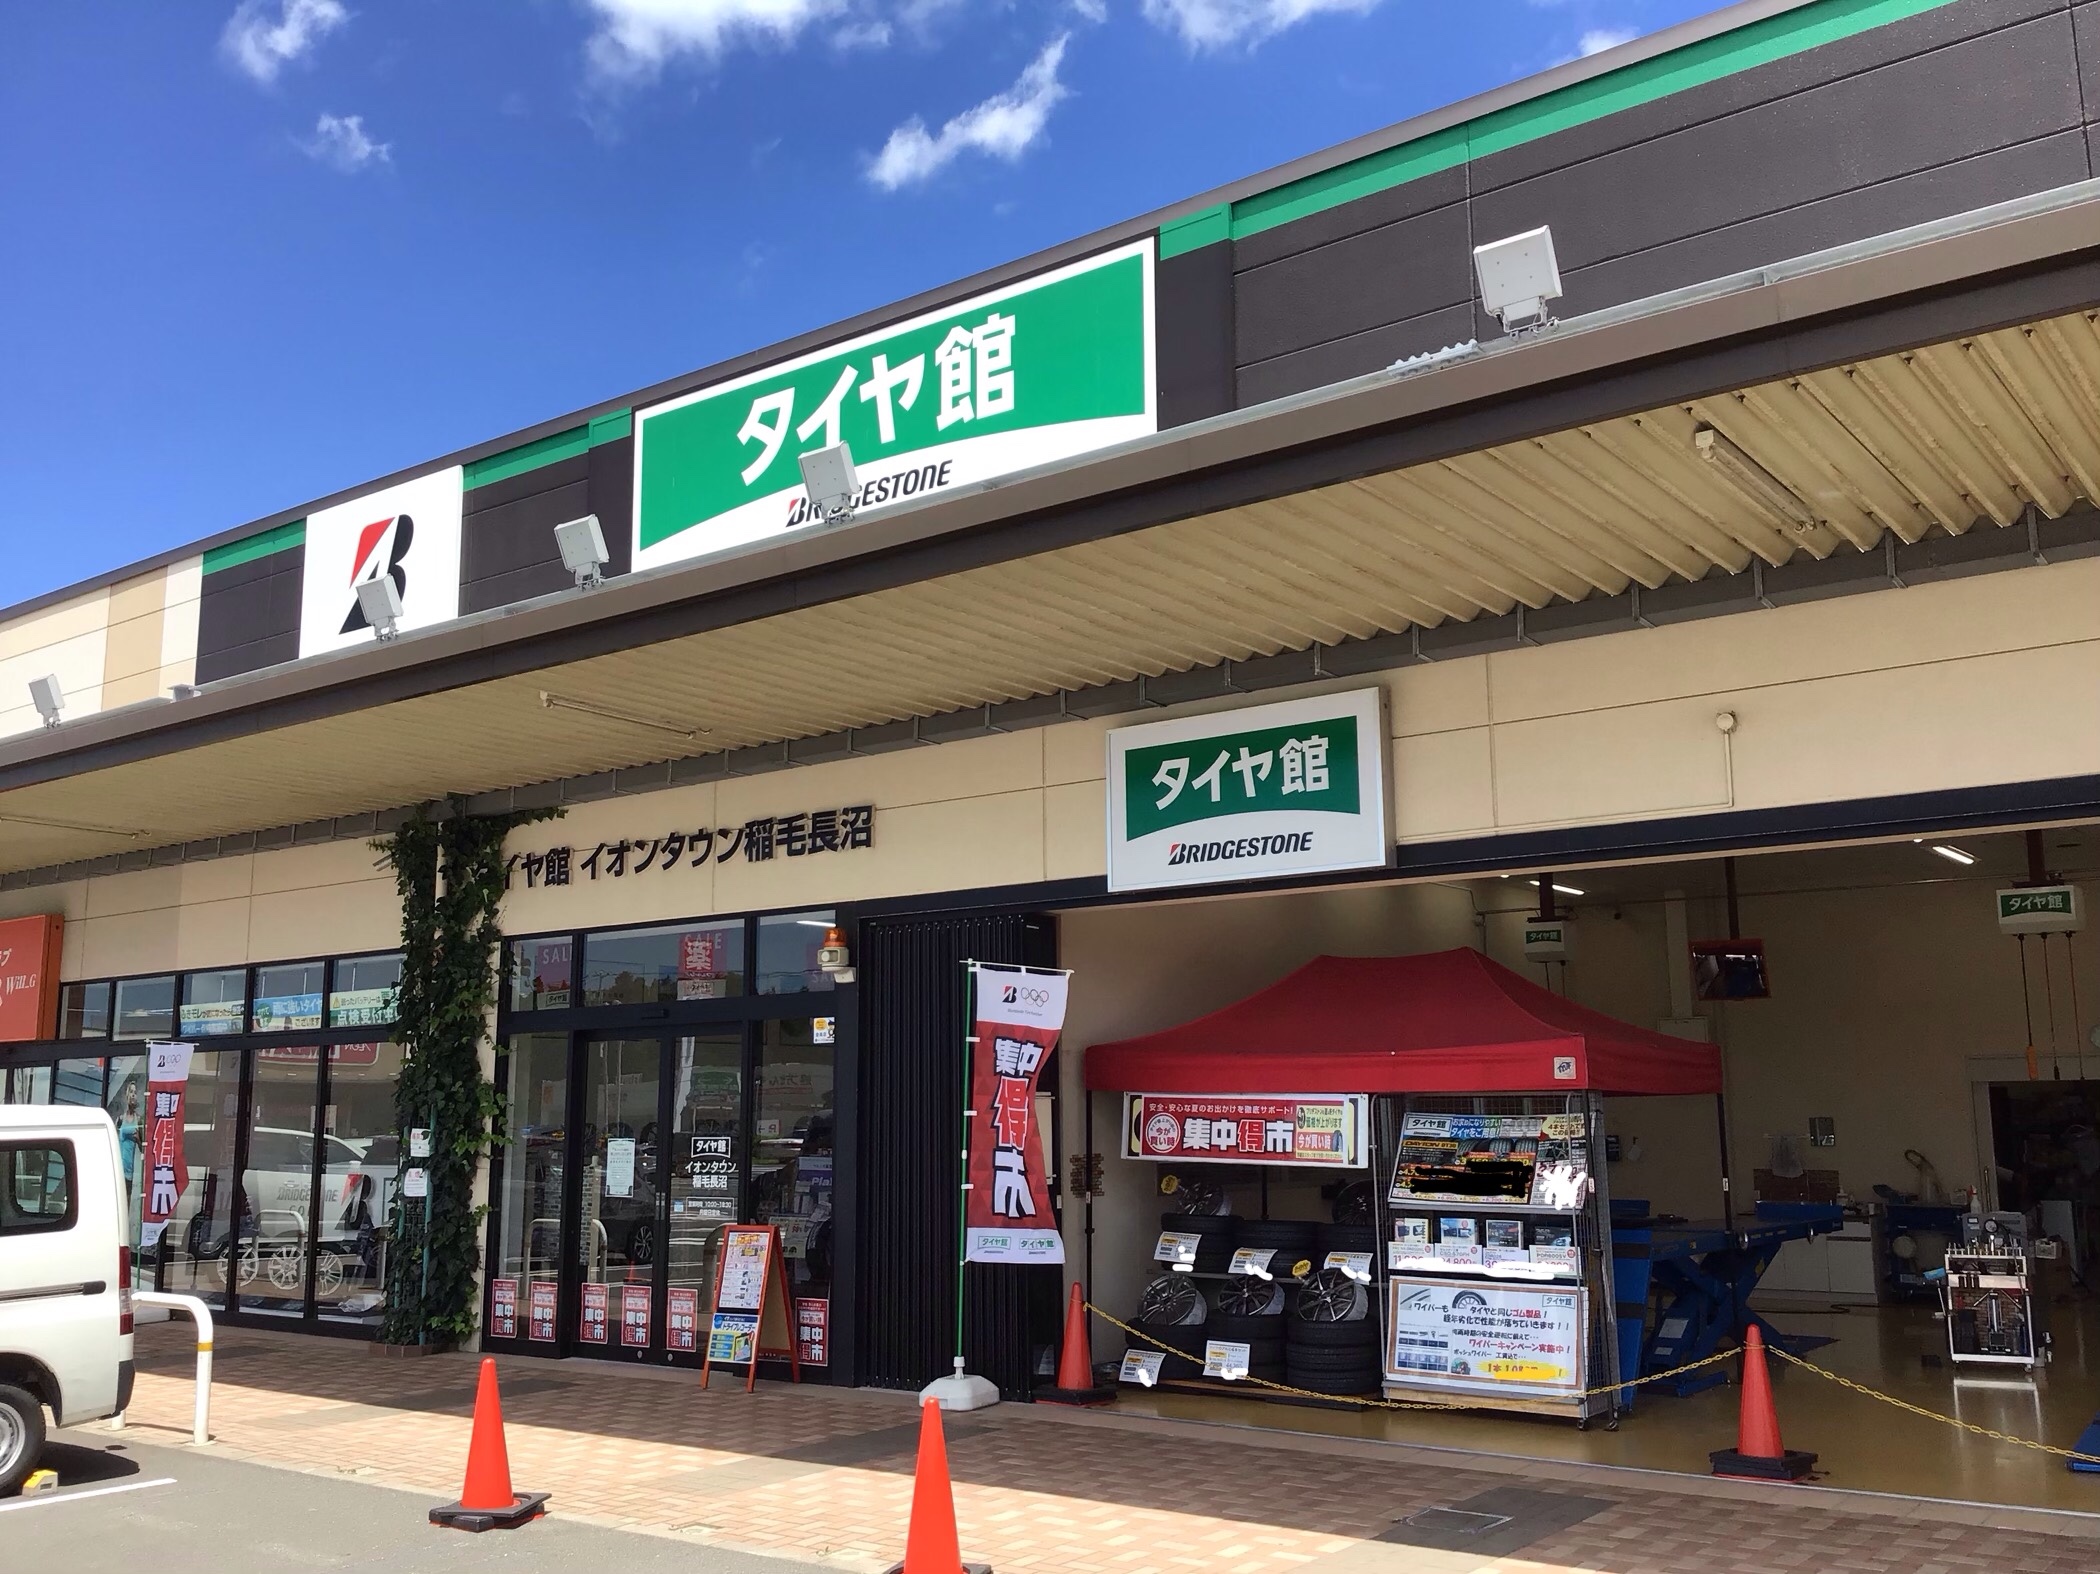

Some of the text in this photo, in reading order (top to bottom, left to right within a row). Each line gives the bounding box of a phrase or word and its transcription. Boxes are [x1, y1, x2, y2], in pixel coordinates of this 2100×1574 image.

[736, 312, 1017, 487] タイヤ館
[786, 458, 953, 528] BRGESTONE
[1151, 733, 1330, 811] タイヤ館
[494, 804, 875, 890] イヤ館 イオンタウン稲毛長沼
[1167, 830, 1314, 866] BRIDGESTONE
[2009, 894, 2063, 911] タイヤ館
[1155, 1126, 1172, 1136] 今が
[1412, 1119, 1448, 1129] タイヤ館
[1150, 1135, 1176, 1147] 買い時
[1182, 1117, 1294, 1154] 集中得市
[1298, 1133, 1332, 1150] 今が買い時
[695, 1139, 727, 1152] タイヤ館
[684, 1159, 737, 1173] イオンタウン
[692, 1174, 728, 1188] 稲毛長沼
[1413, 1303, 1450, 1313] ワイパーも
[1545, 1297, 1573, 1306] タイヤ館
[799, 1325, 824, 1342] 集中
